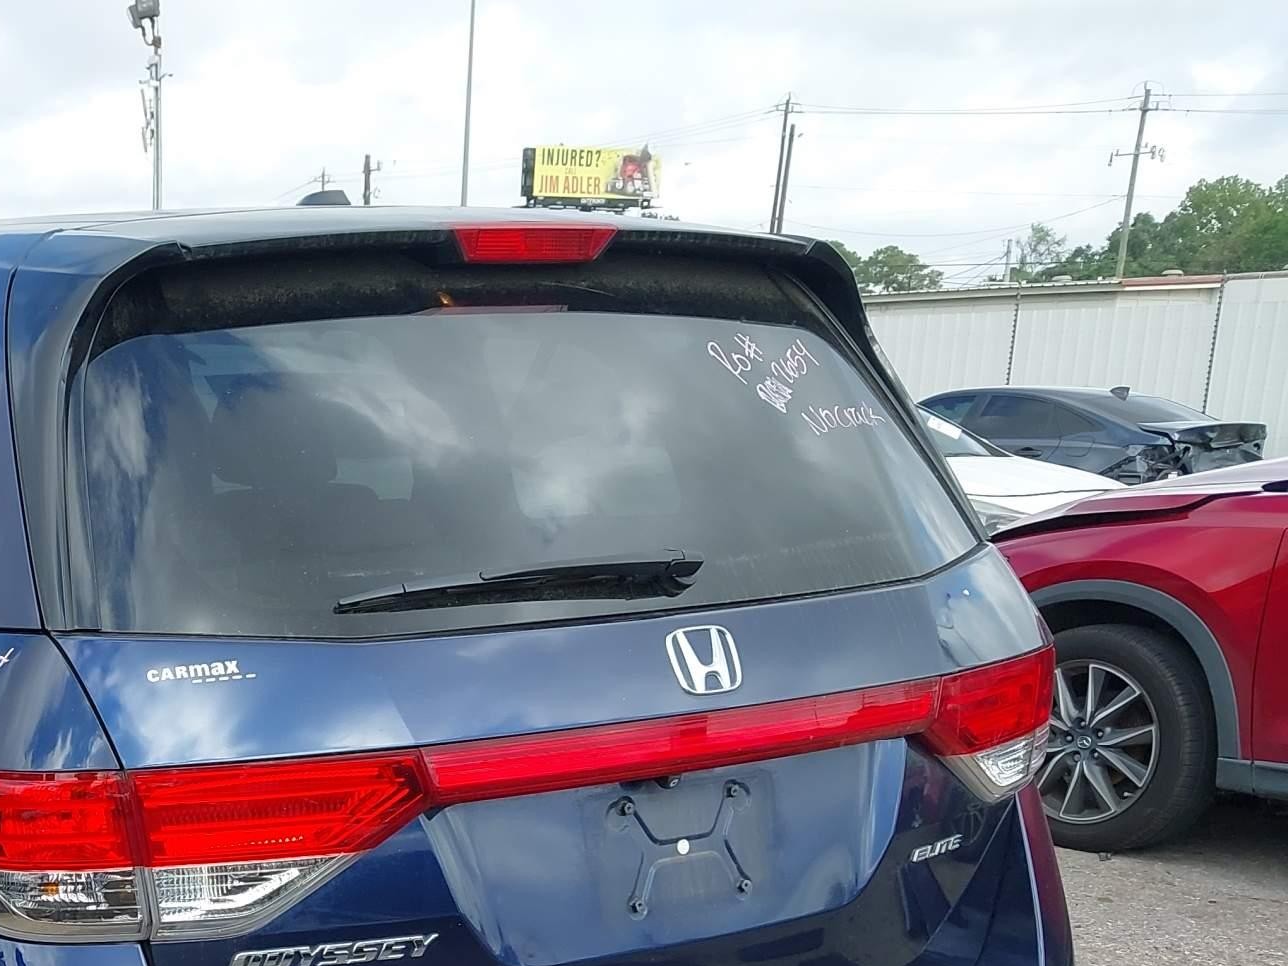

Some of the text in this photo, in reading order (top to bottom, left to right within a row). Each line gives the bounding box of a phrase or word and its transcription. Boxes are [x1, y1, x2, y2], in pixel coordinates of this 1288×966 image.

[541, 147, 602, 168] INJURED?
[538, 174, 601, 195] JIM ADLER
[910, 833, 964, 863] ELITE
